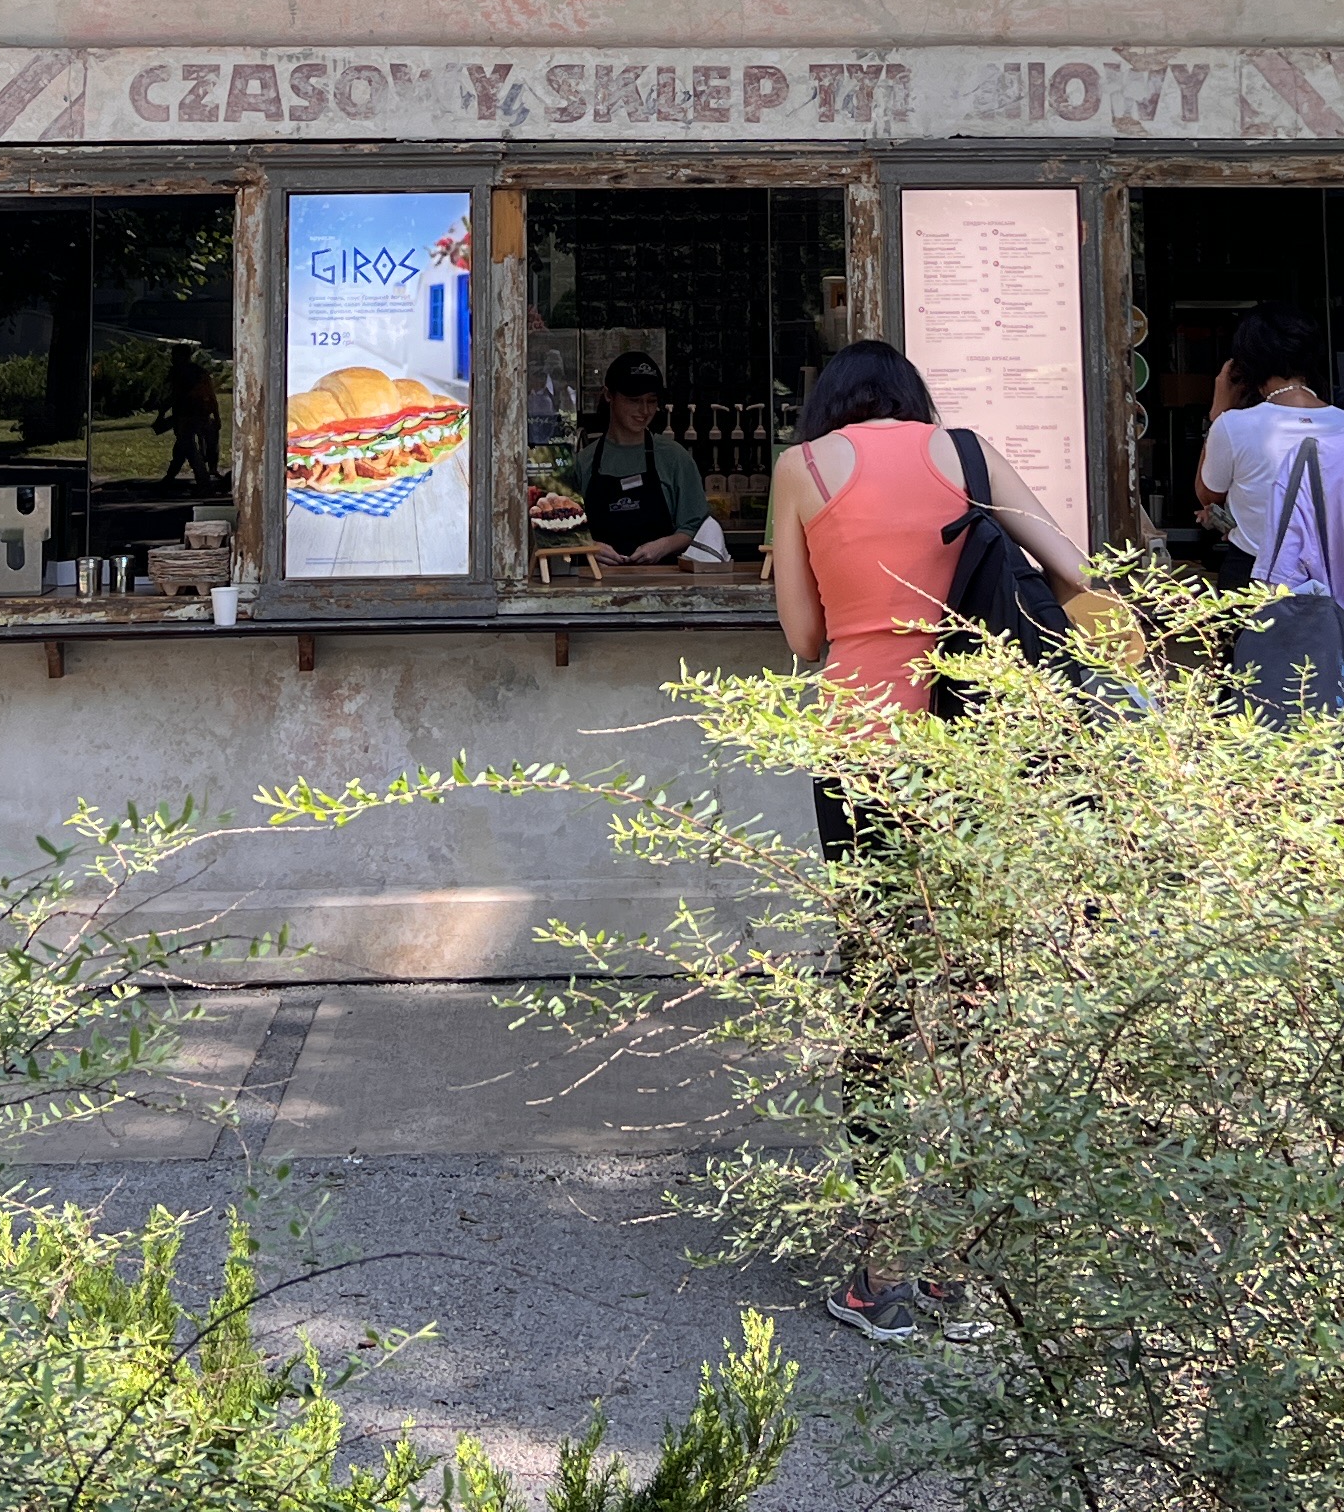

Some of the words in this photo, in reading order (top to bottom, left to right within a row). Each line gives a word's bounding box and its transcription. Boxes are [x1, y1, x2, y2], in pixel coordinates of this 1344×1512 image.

[543, 63, 791, 124] SKLEP
[311, 246, 420, 286] GIROS
[310, 331, 342, 346] 129
